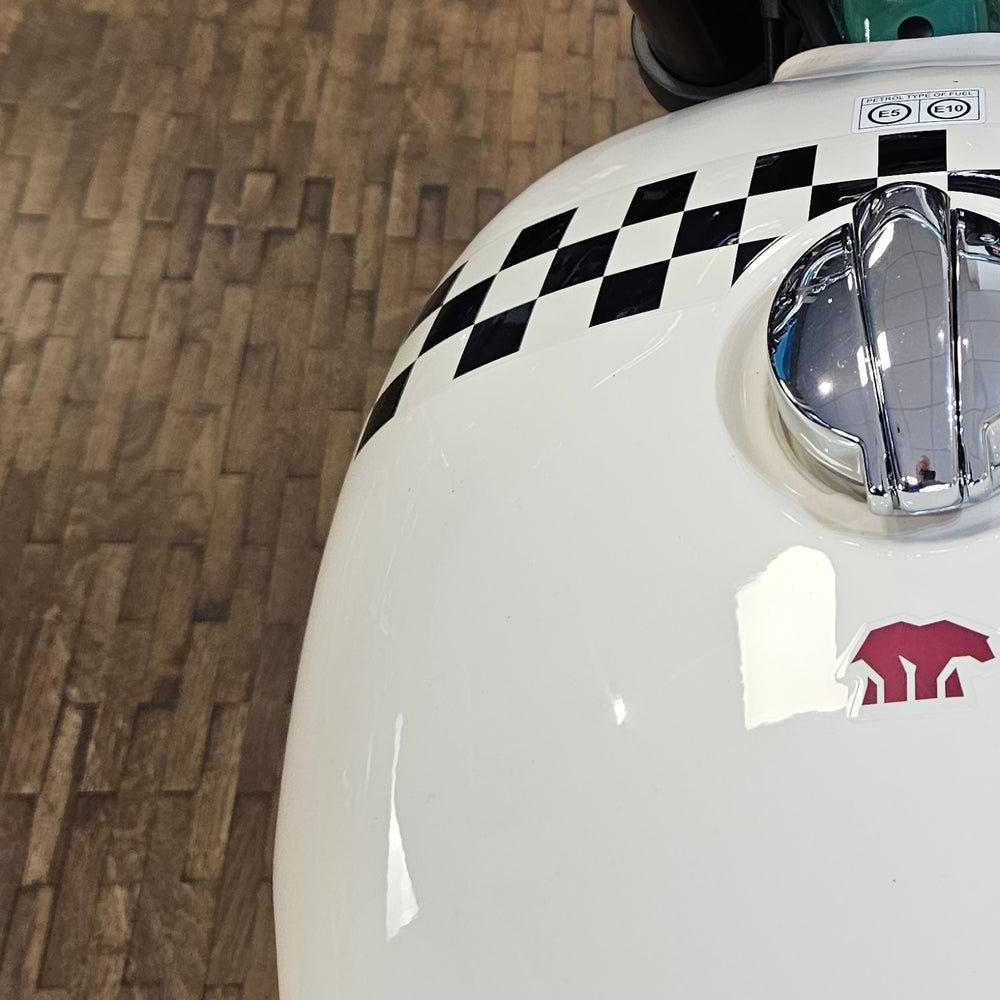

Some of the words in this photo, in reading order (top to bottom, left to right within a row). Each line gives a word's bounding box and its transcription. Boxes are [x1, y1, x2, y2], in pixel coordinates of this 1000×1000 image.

[866, 95, 904, 104] PETROL
[934, 105, 964, 113] E10
[878, 109, 901, 119] E5
